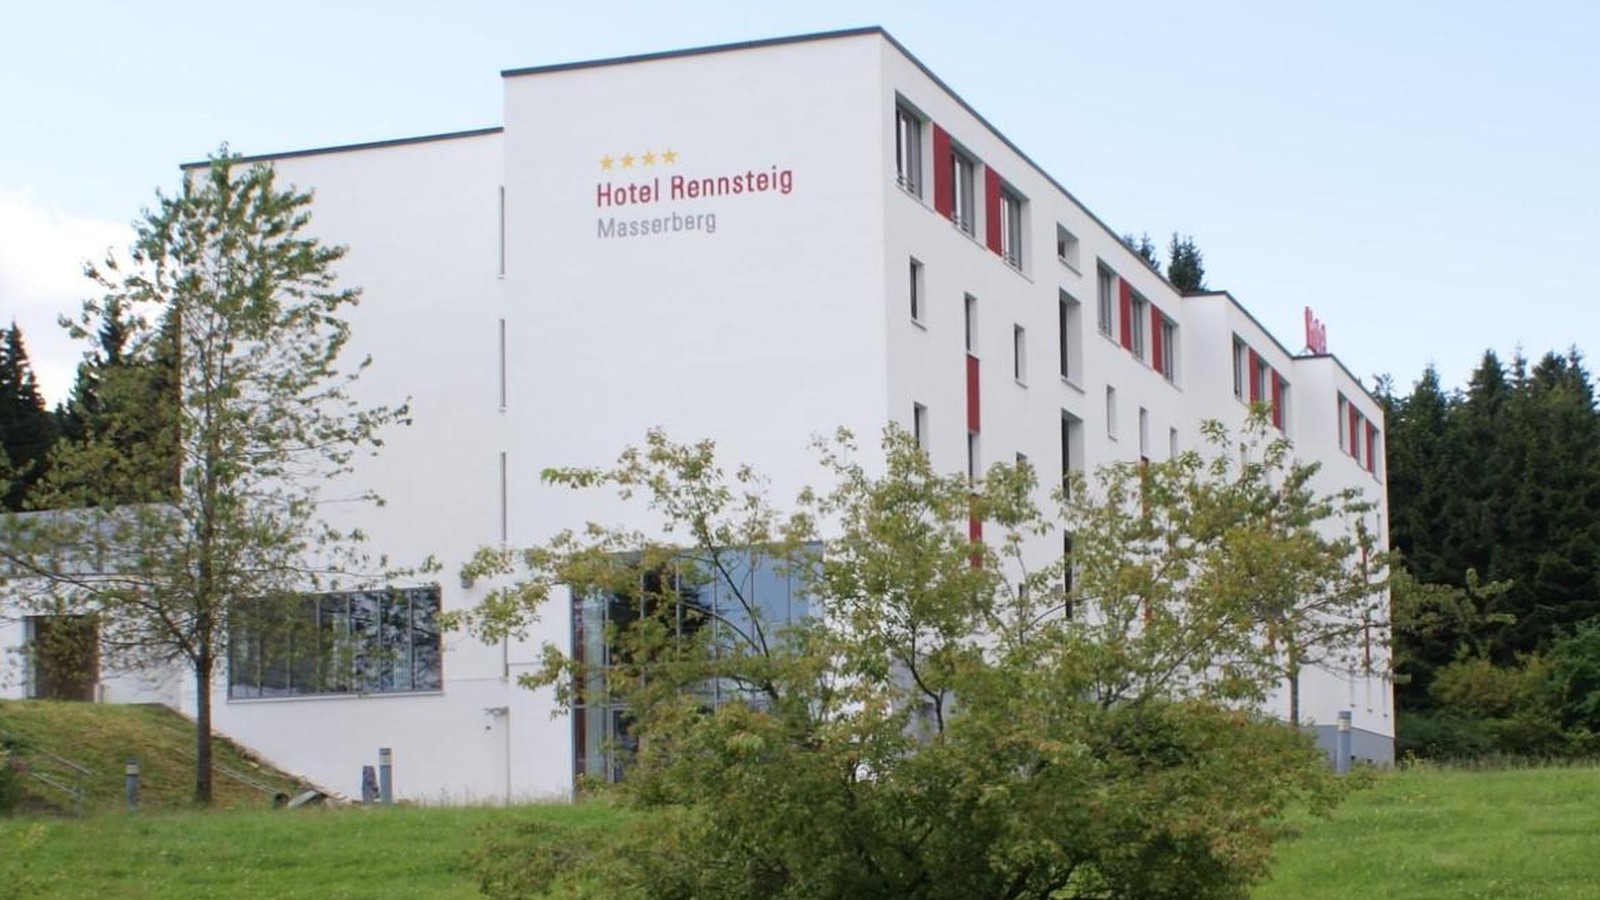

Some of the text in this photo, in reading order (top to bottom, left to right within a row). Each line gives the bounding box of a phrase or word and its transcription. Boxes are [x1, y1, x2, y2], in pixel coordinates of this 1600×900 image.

[597, 165, 793, 208] Hotel Rennsteig
[597, 211, 717, 239] Masserberg
